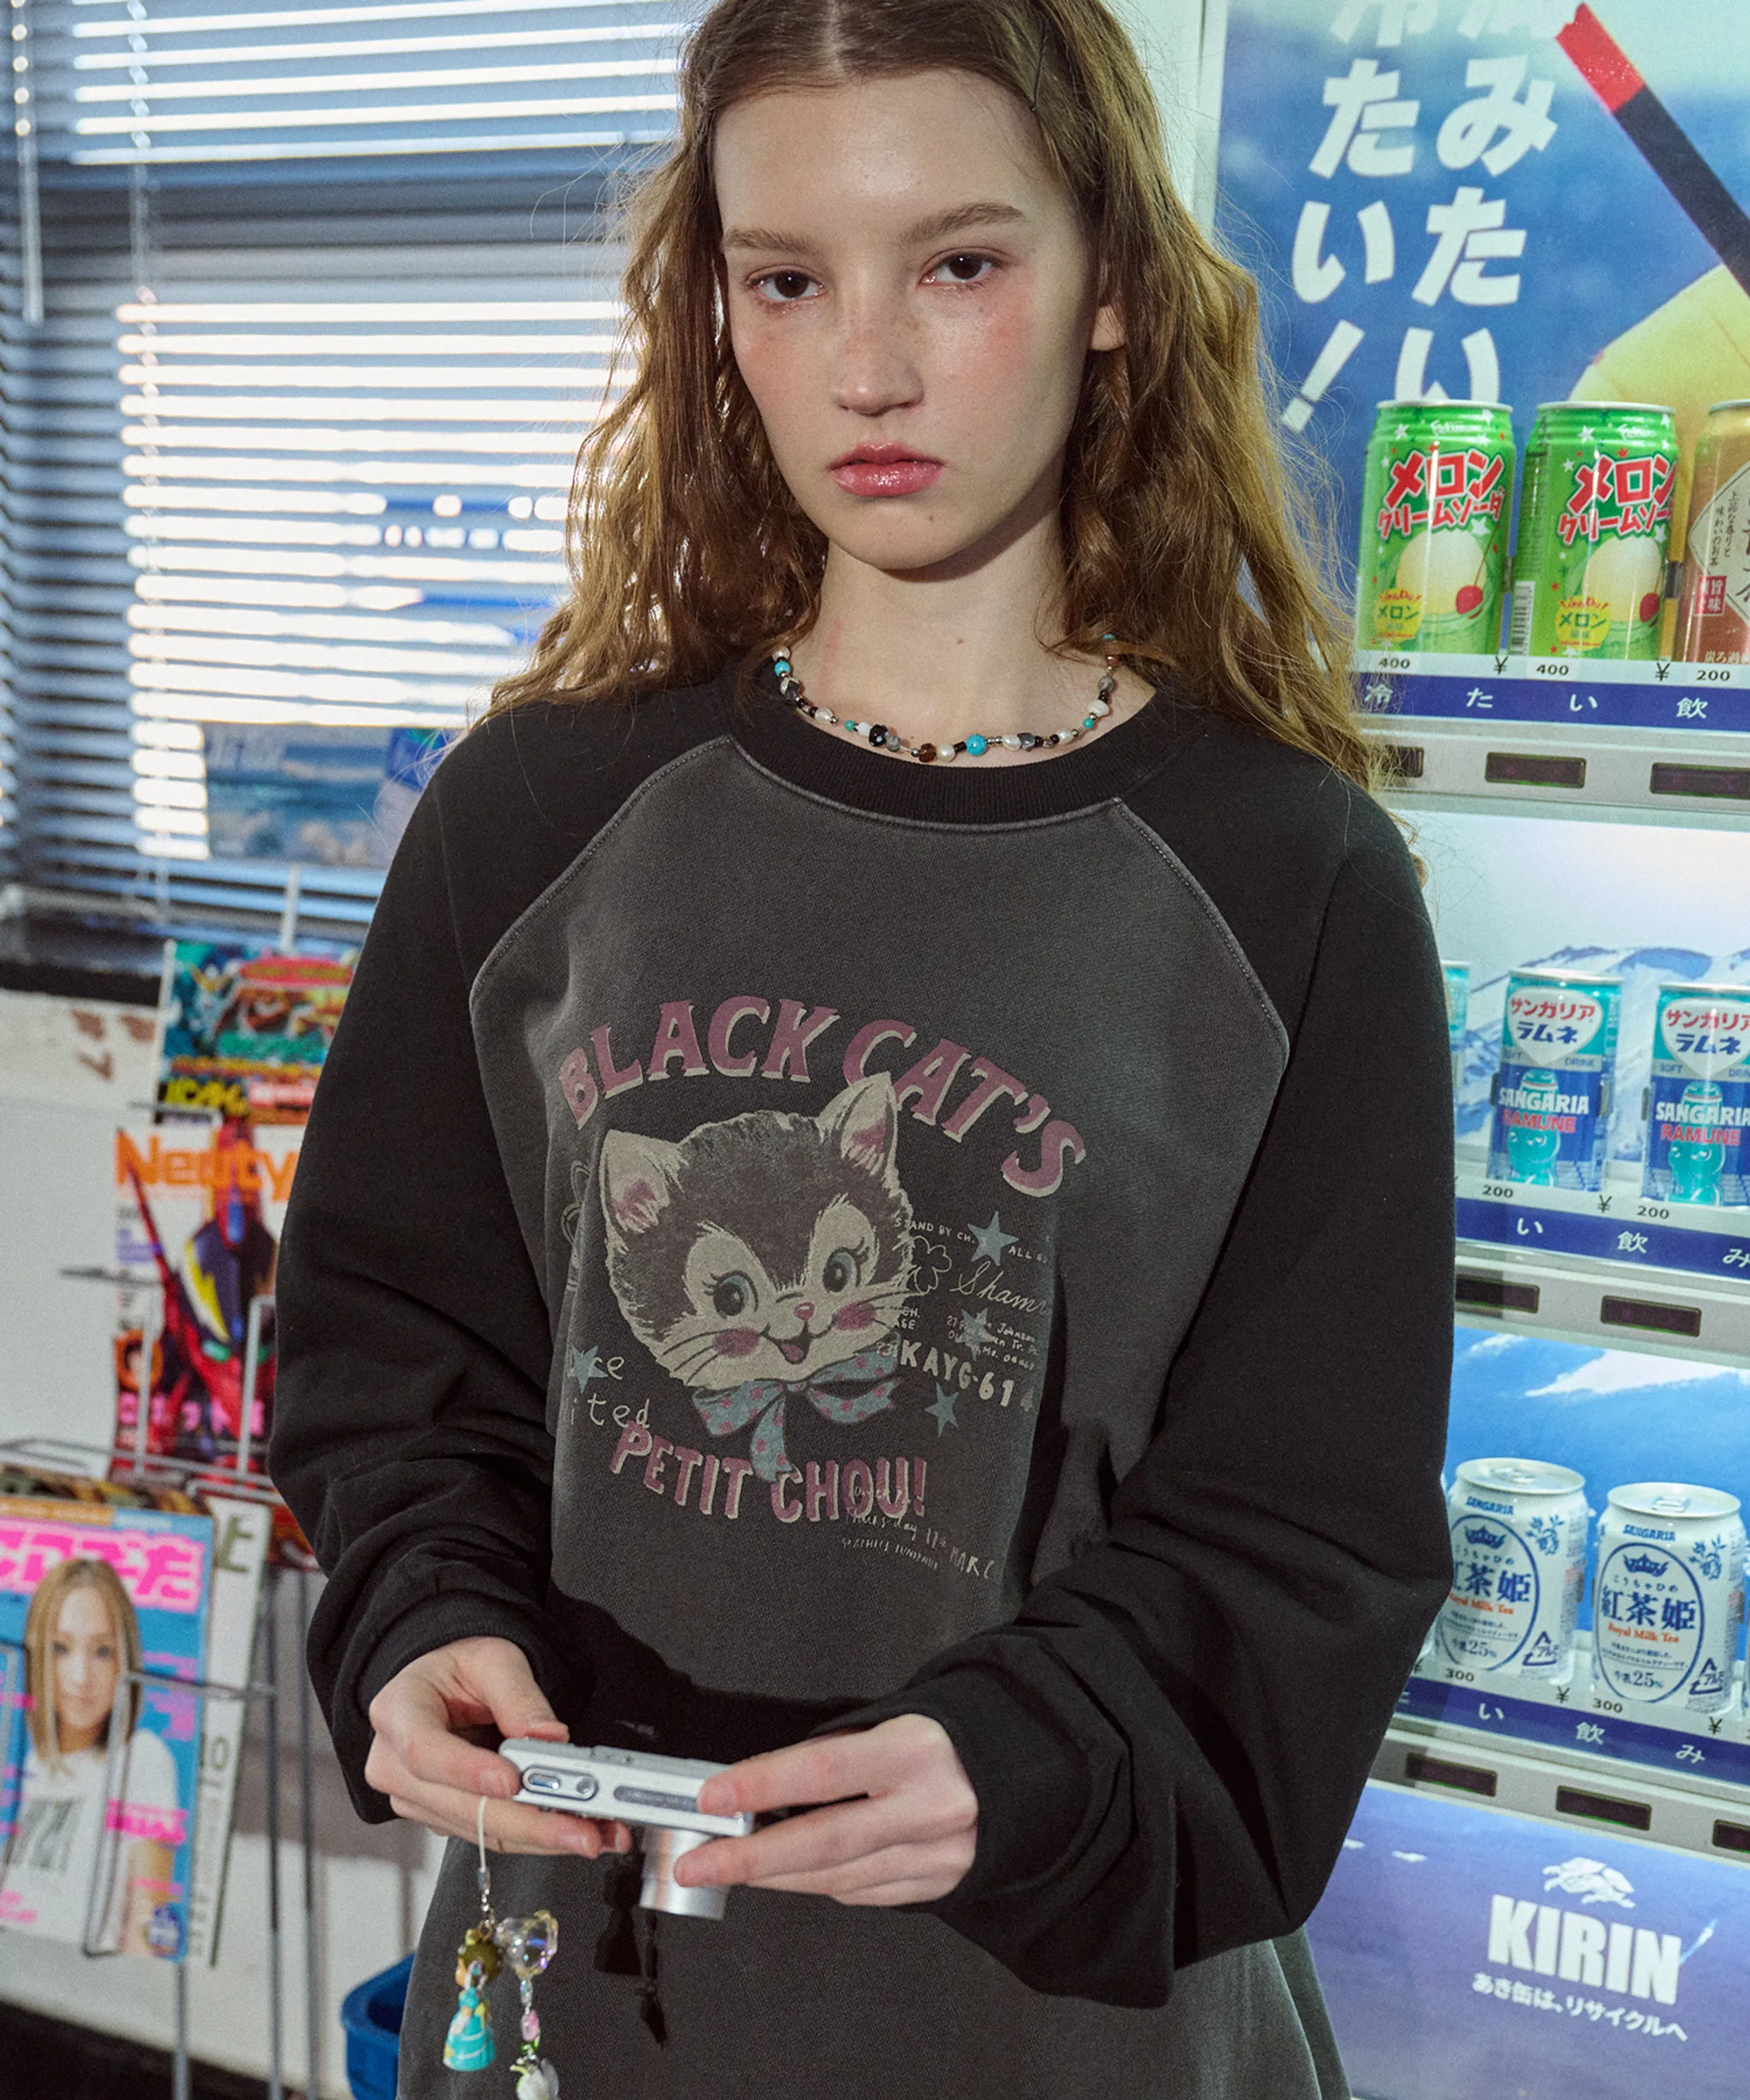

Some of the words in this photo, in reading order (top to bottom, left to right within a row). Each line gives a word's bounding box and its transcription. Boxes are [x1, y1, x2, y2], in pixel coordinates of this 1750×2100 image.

[1384, 448, 1504, 509] メロン
[1567, 453, 1677, 516] メロン
[1377, 486, 1506, 541] クリームソーダ
[1557, 497, 1673, 545] クリームソー
[1377, 604, 1420, 620] メロン
[1559, 612, 1607, 629] メロン
[1378, 657, 1411, 669] 400
[1536, 664, 1569, 675] 400
[1696, 670, 1730, 682] 200
[1511, 996, 1596, 1021] サンガリア
[1516, 1021, 1578, 1044] ラムネ
[1675, 1033, 1742, 1056] ラムネ
[1659, 1063, 1683, 1074] SOFT
[1728, 1068, 1750, 1078] DRIN
[558, 995, 840, 1130] BLACK
[842, 1019, 1086, 1197] CAT'S
[1498, 1087, 1590, 1115] SANGARIA
[1502, 1108, 1578, 1134] RAMUNE
[1655, 1101, 1750, 1127] SANGARIA
[1660, 1123, 1742, 1146] RAMUNE
[1482, 1184, 1514, 1199] 200
[1636, 1205, 1670, 1220] 200
[609, 1420, 753, 1519] PETIT
[771, 1456, 927, 1523] CHOU!
[1601, 1585, 1697, 1631] 紅茶姫
[1608, 1621, 1631, 1638] Royal
[1633, 1629, 1658, 1643] Milk
[1661, 1631, 1680, 1643] Tea
[1445, 1667, 1475, 1682] 300
[1592, 1698, 1624, 1714] 300
[1487, 1893, 1682, 2005] KIRIN
[1471, 1971, 1688, 2043] あき缶は、リサイクルへ
